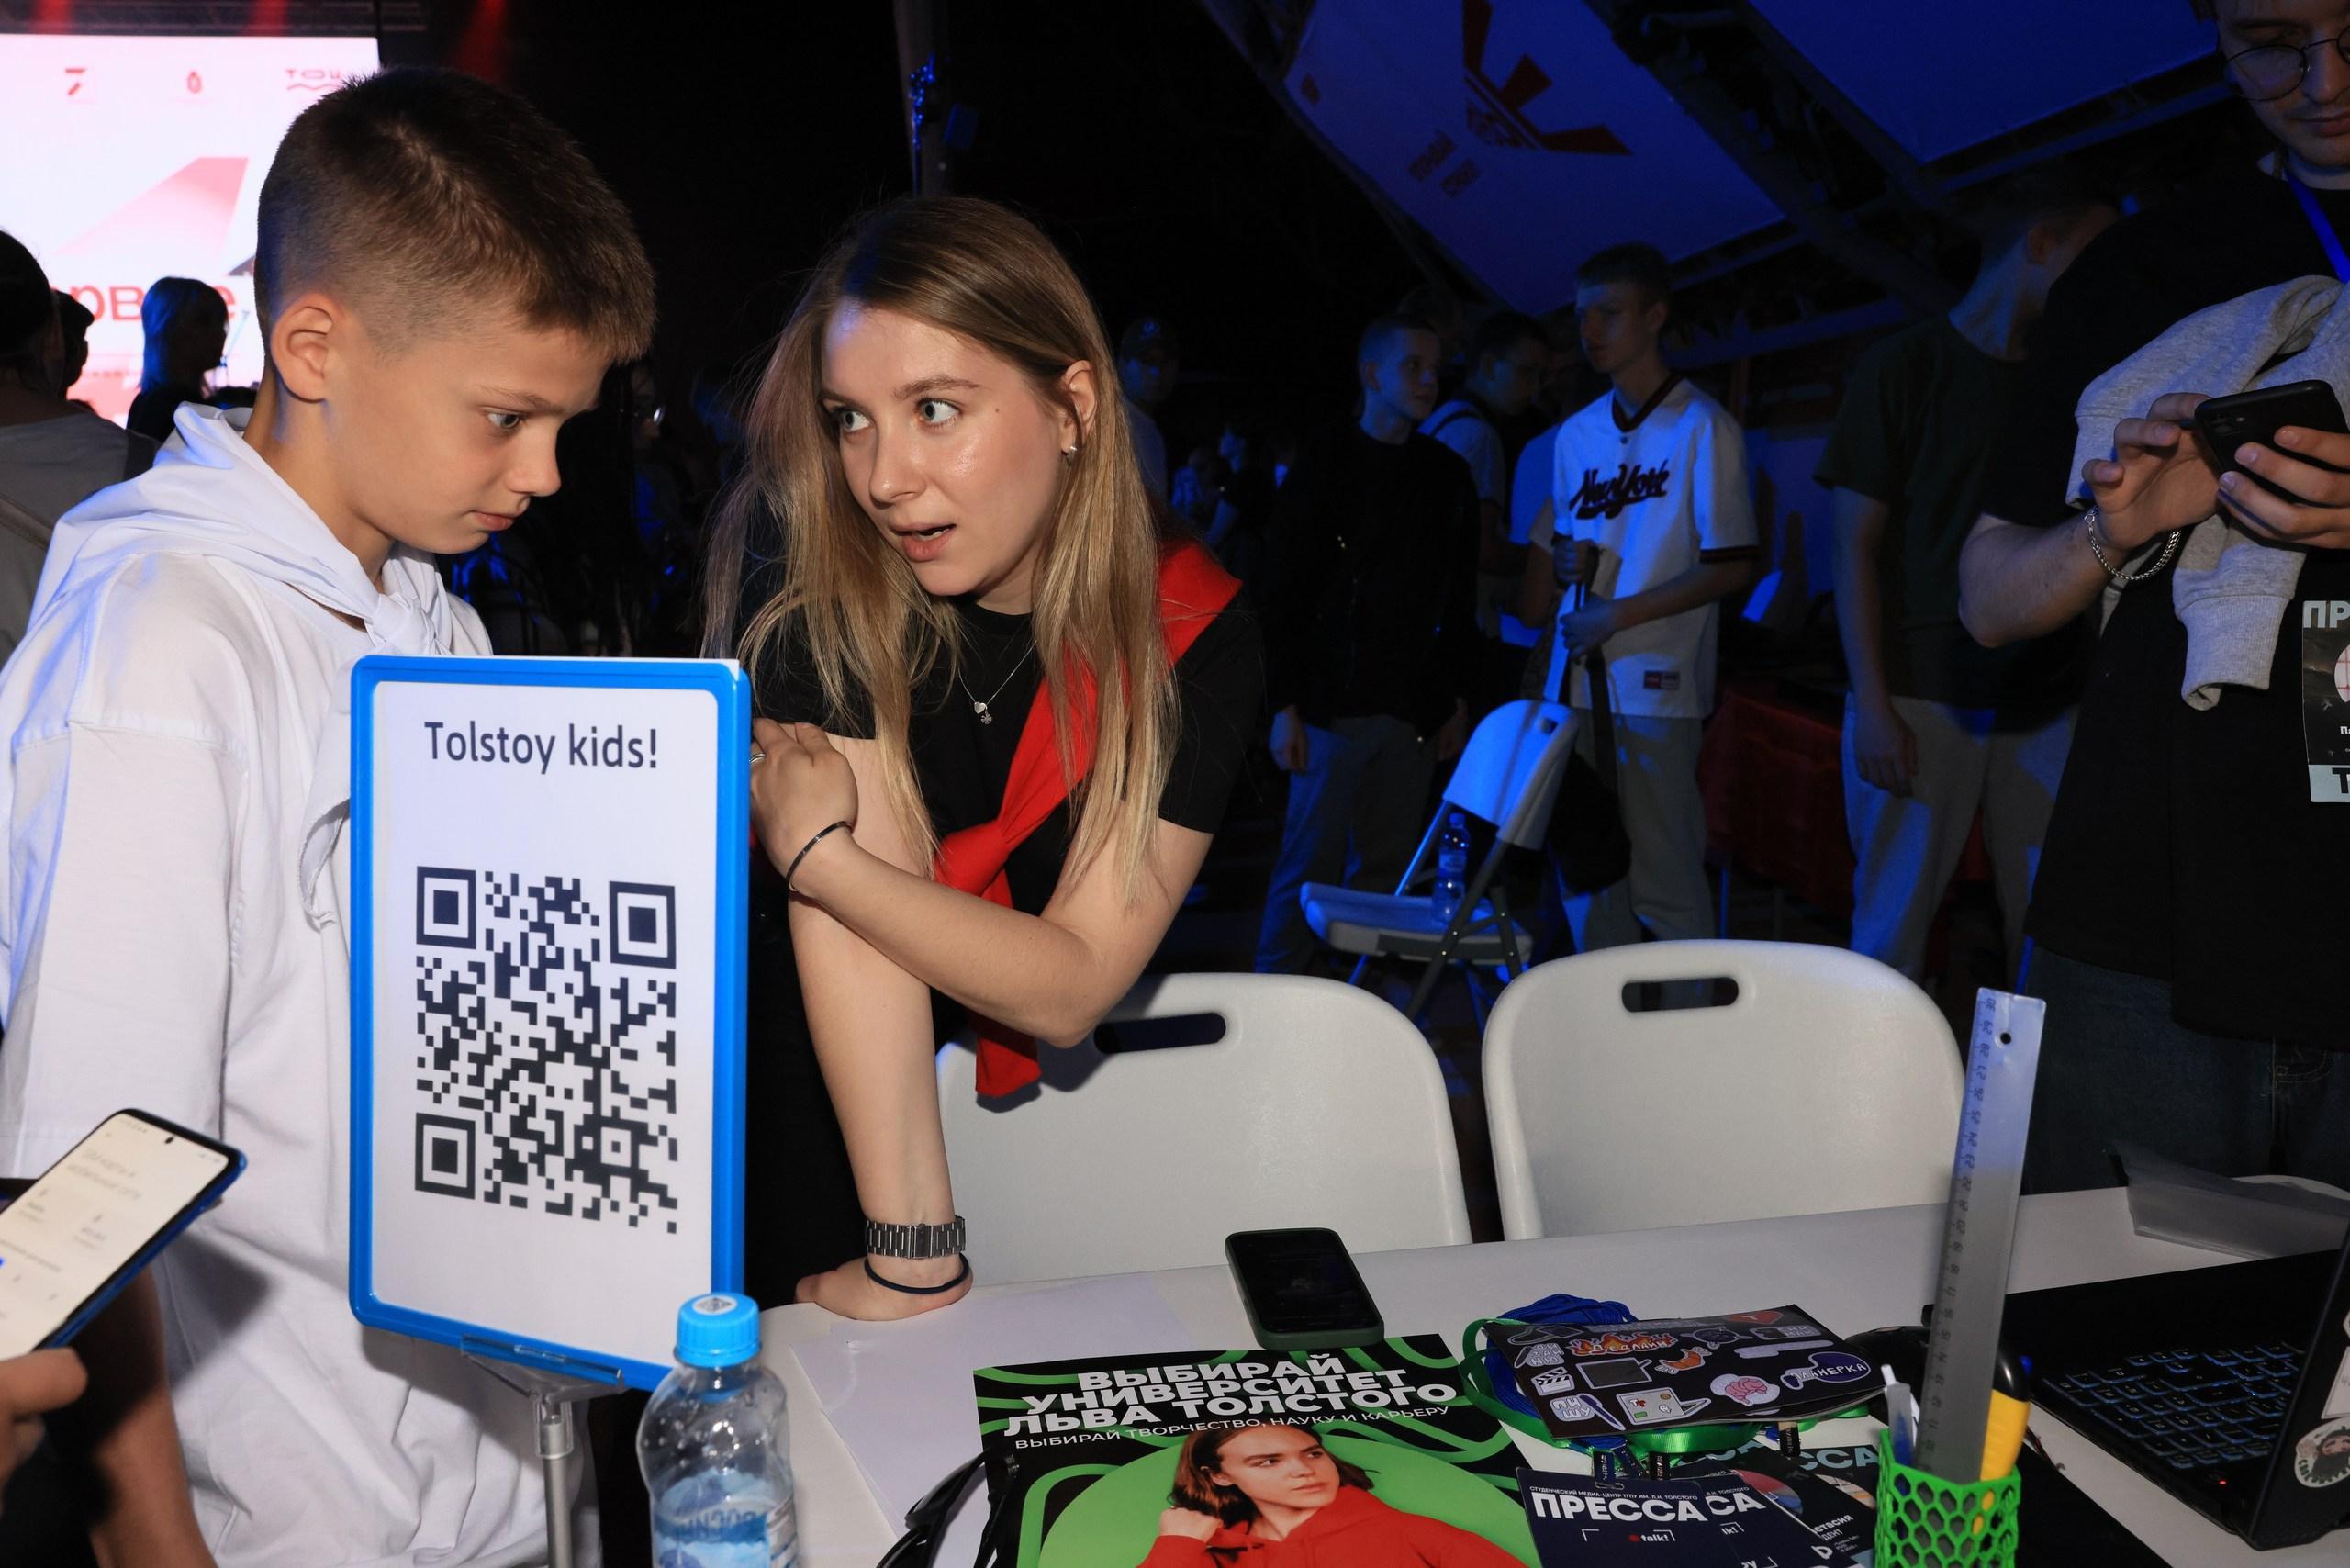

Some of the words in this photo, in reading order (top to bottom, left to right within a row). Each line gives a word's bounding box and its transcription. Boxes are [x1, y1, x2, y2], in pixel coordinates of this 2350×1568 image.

[424, 720, 555, 775] Tolstoy
[568, 722, 658, 769] kids!
[1021, 1369, 1407, 1415] УНИВЕРСИТЕТ
[1077, 1353, 1347, 1391] ВЫБИРАЙ
[1004, 1405, 1162, 1437] ЛЬВА
[1171, 1383, 1457, 1419] ТОЛСТОГО
[1015, 1429, 1121, 1449] ВЫБИРАЙ
[1125, 1418, 1266, 1438] ТВОРЧЕСТВО,
[1270, 1414, 1337, 1427] НАУКУ
[1341, 1414, 1357, 1423] И
[1361, 1406, 1449, 1421] КАРЬЕРУ
[1531, 1492, 1708, 1521] ПРЕССА
